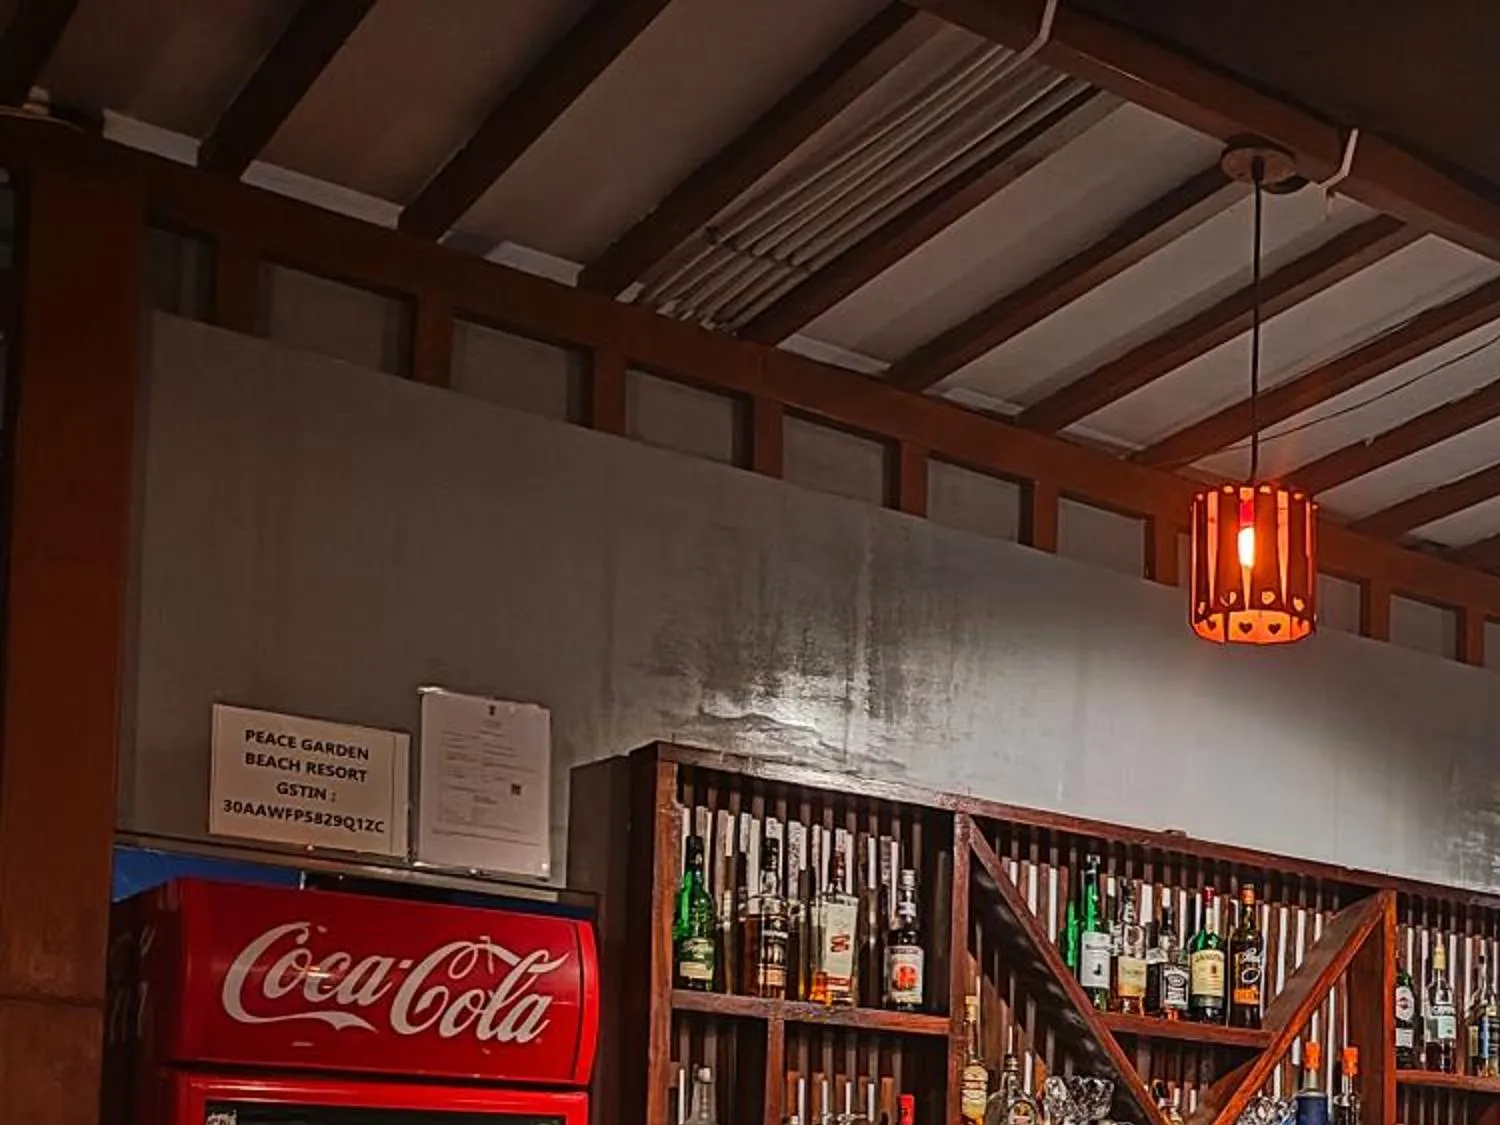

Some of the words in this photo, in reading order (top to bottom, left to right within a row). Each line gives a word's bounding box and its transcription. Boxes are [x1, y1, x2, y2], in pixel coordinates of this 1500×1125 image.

[244, 729, 297, 749] PEACE
[301, 739, 369, 761] GARDEN
[244, 752, 300, 773] BEACH
[305, 761, 367, 783] RESORT
[276, 781, 327, 801] GSTIN
[223, 799, 385, 834] 30AAWFP5829Q1ZC
[221, 921, 569, 1044] Coca-Cola
